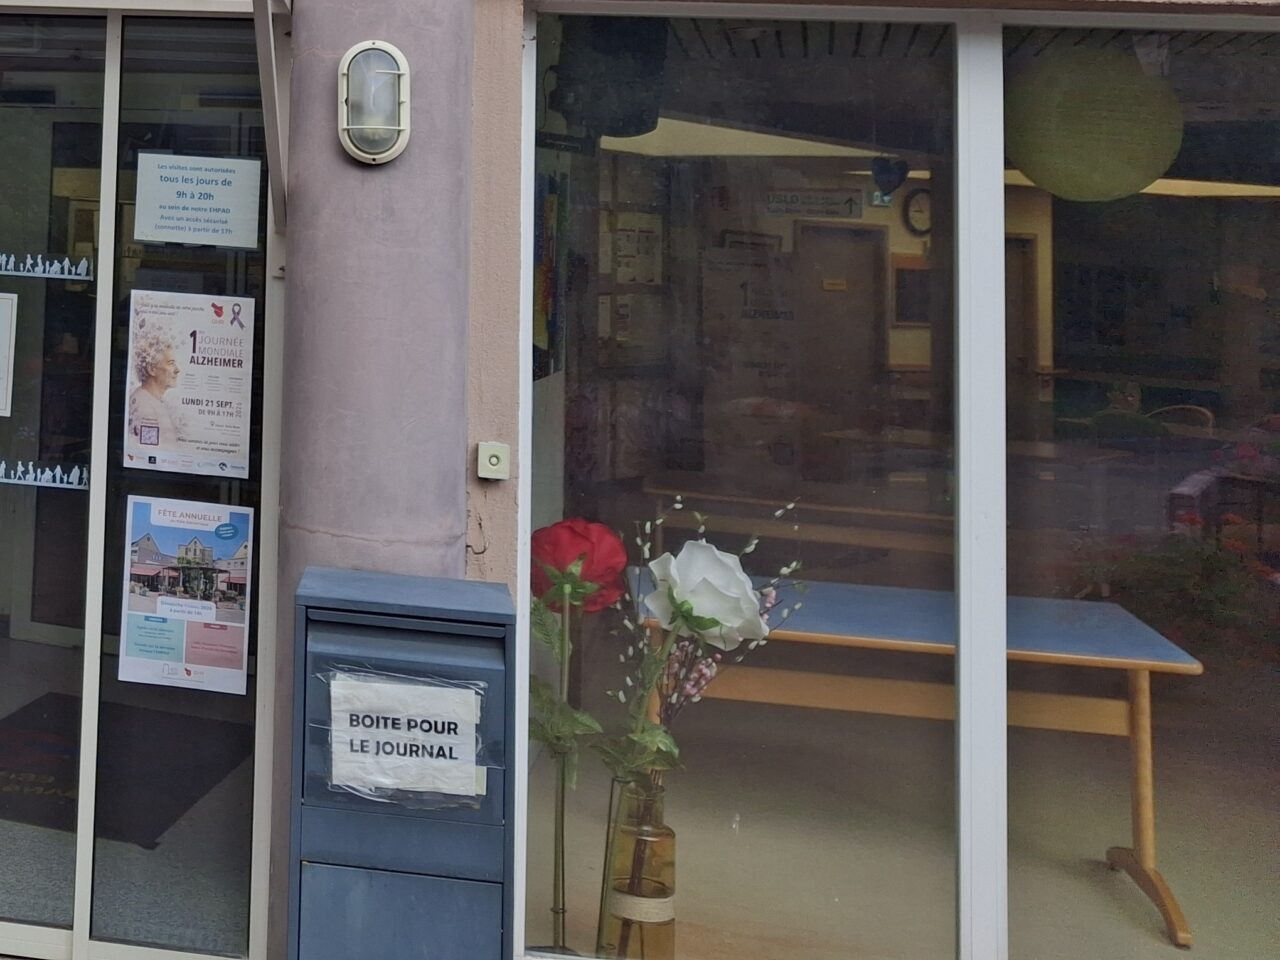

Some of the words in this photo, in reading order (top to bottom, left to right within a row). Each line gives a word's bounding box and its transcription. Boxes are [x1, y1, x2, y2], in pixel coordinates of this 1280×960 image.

[160, 175, 179, 183] tous
[181, 175, 194, 183] les
[195, 176, 219, 186] jours
[221, 178, 233, 187] de
[176, 191, 187, 199] 9h
[189, 191, 195, 199] à
[197, 192, 214, 201] 20h
[189, 330, 197, 354] 1
[198, 334, 245, 347] JOURNÉE
[198, 346, 244, 359] MONDIALE
[189, 355, 243, 368] ALZHEIMER
[181, 397, 204, 406] LUNDI
[205, 399, 214, 407] 21
[216, 400, 234, 409] SEPT.
[198, 408, 206, 416] DE
[158, 509, 177, 518] FÊTE
[179, 512, 223, 522] ANNUELLE
[349, 713, 401, 730] BOITE
[407, 718, 459, 735] POUR
[350, 739, 370, 753] LE
[375, 740, 459, 760] JOURNAL
